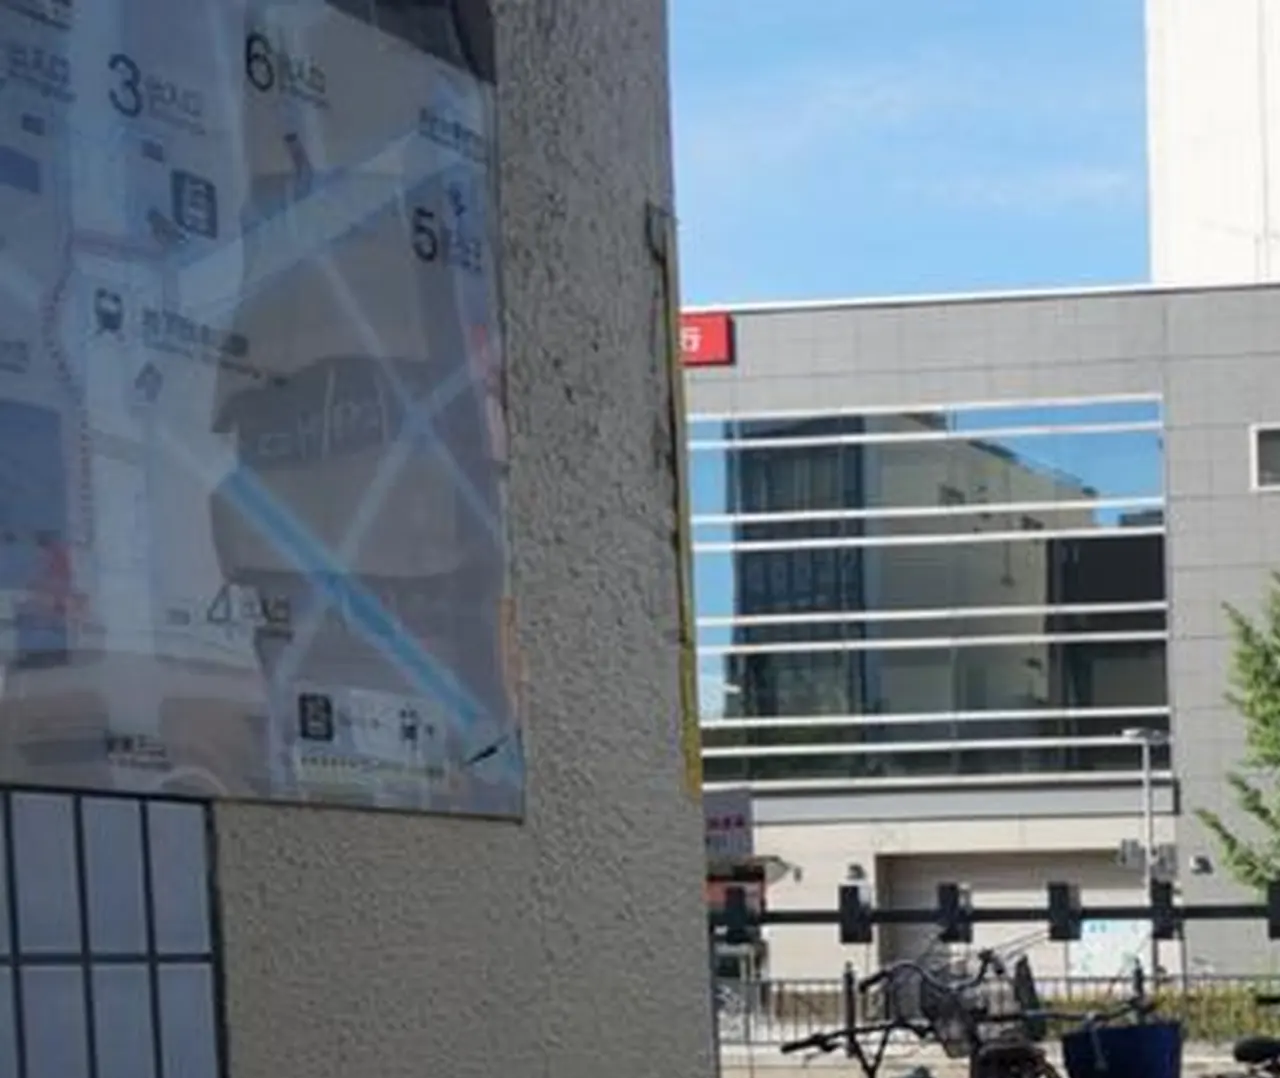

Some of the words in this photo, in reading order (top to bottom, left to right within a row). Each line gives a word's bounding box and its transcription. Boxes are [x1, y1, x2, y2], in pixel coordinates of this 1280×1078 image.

[107, 53, 143, 118] 3
[245, 33, 275, 92] 6
[412, 205, 438, 263] 5
